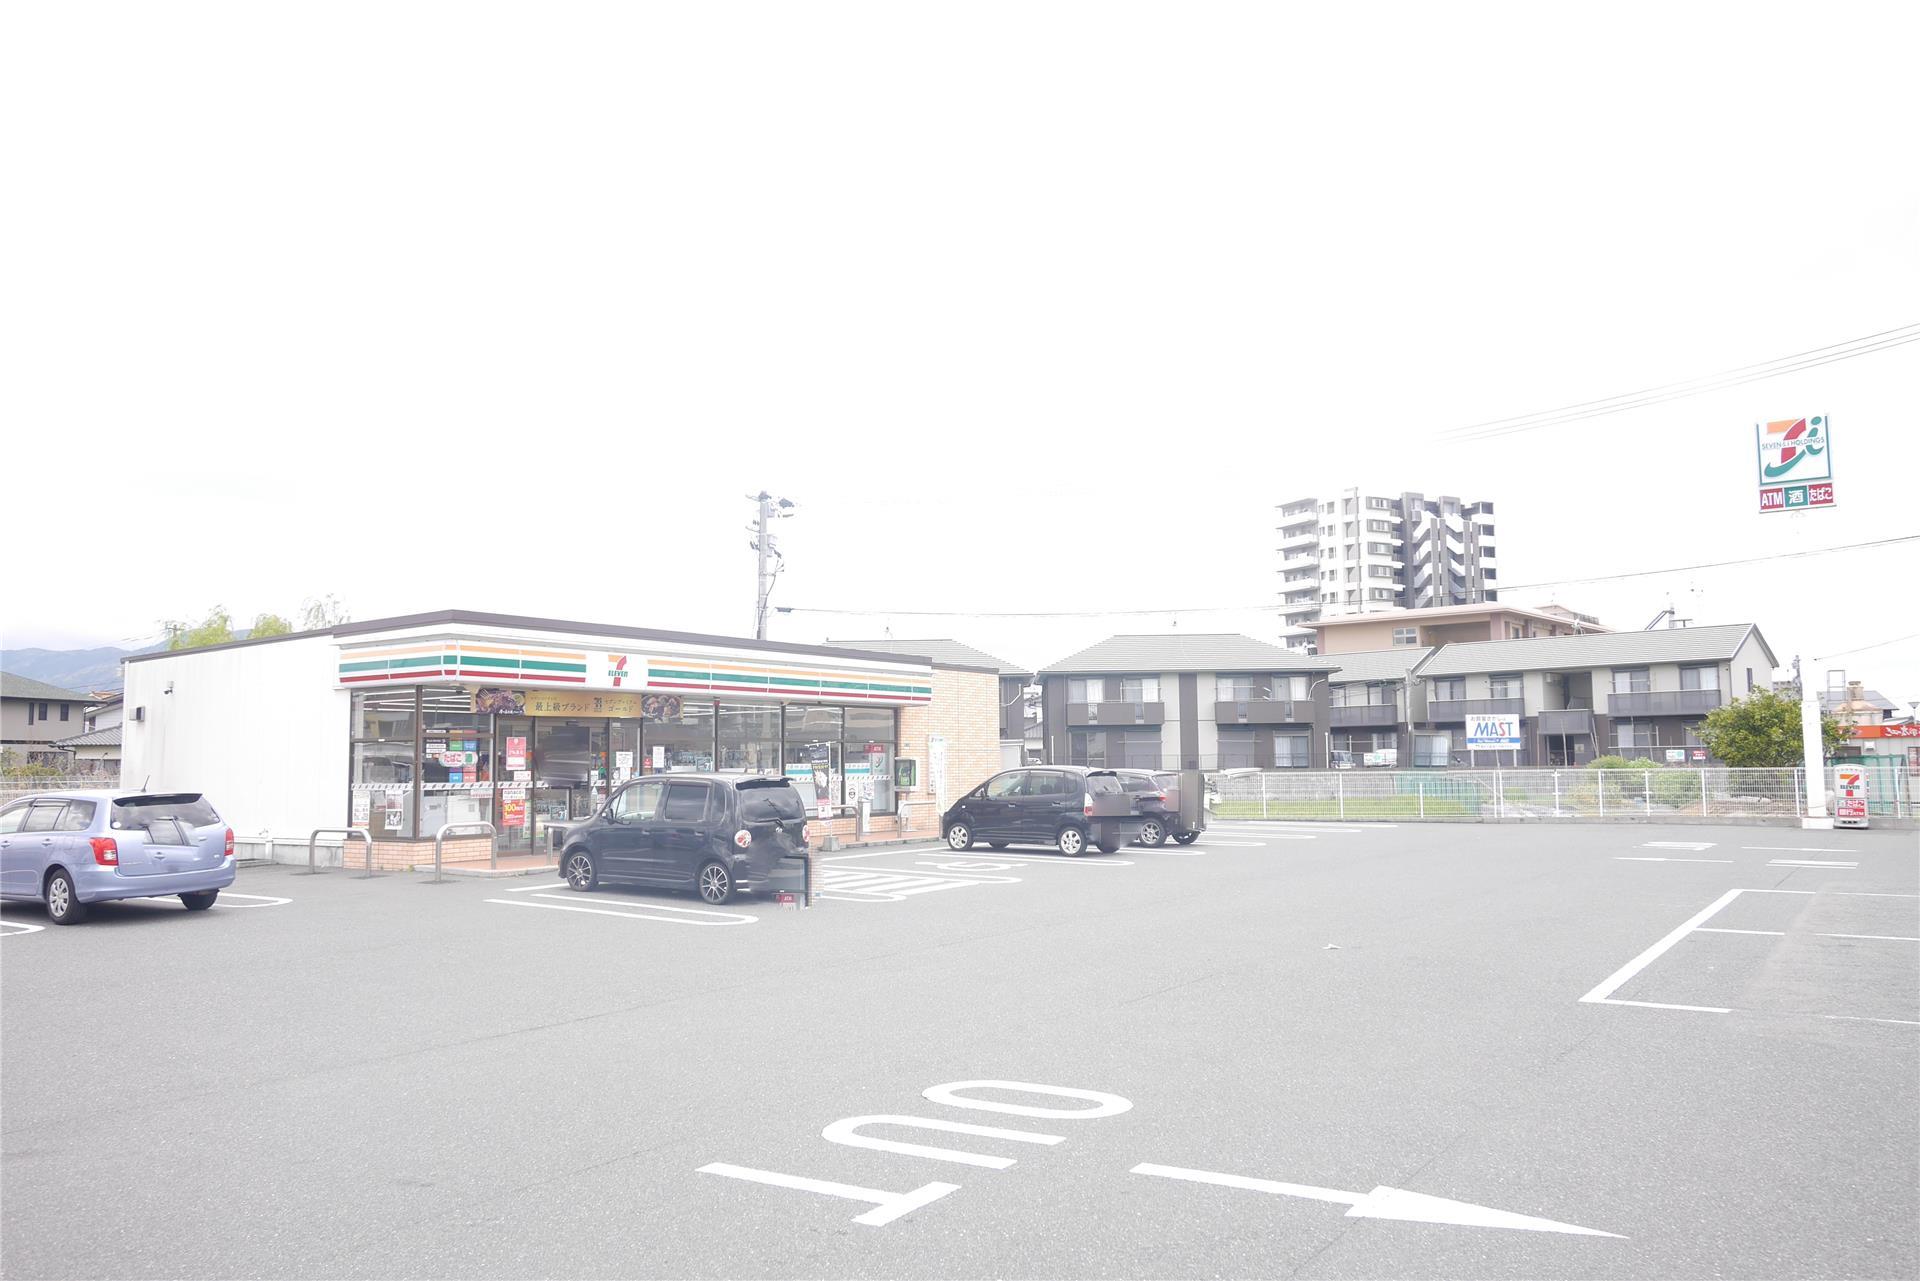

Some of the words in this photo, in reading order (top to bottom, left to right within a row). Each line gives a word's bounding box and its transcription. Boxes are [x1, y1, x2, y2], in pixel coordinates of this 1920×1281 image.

[1761, 492, 1783, 506] ATM
[1788, 489, 1803, 504] 酒
[1809, 487, 1832, 501] たばこ
[1474, 722, 1513, 737] MAST
[695, 1079, 1133, 1226] OUT
